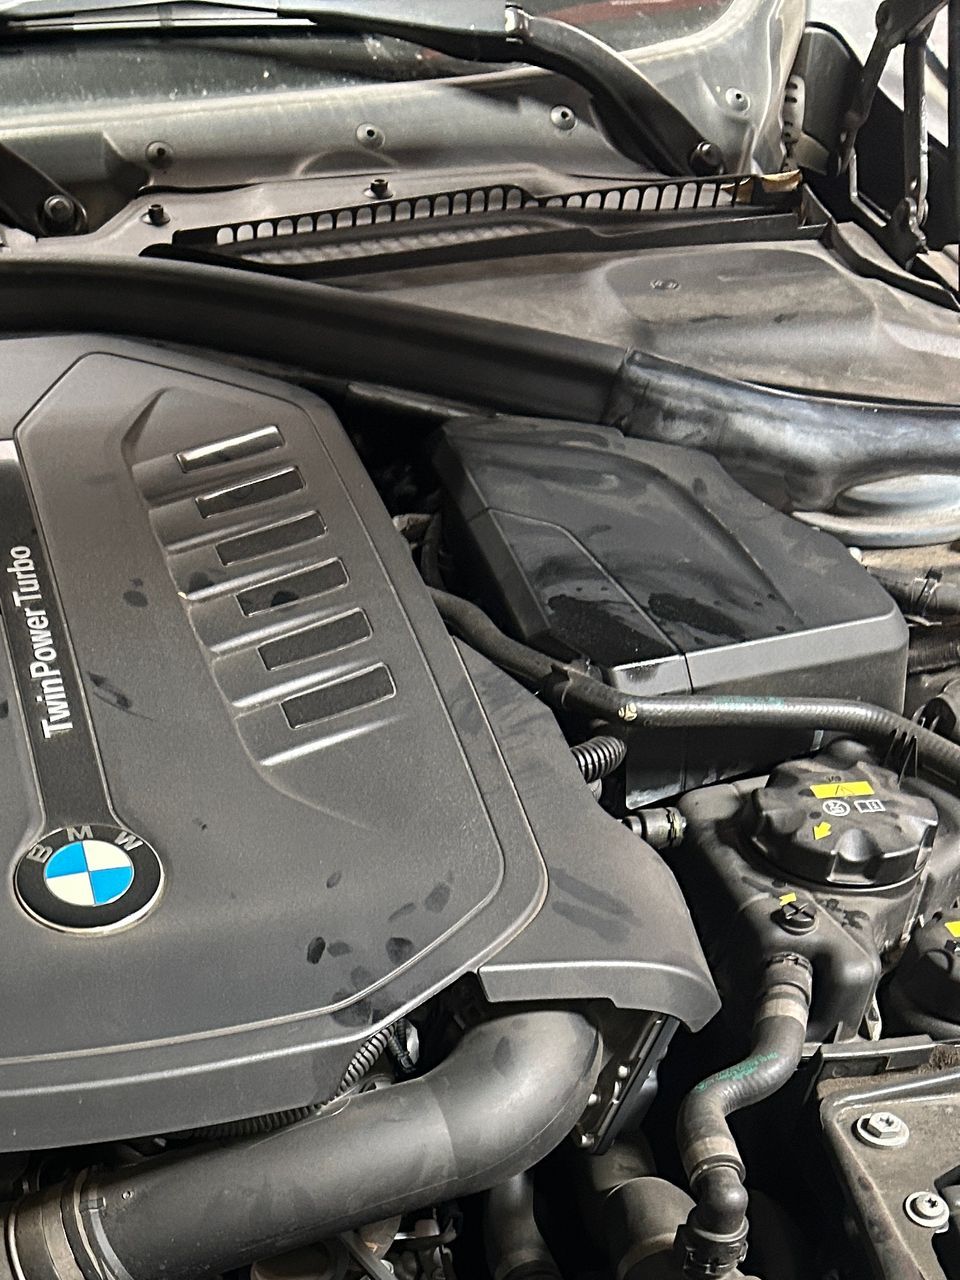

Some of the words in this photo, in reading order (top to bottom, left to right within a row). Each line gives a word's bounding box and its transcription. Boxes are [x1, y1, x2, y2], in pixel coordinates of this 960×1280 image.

[6, 545, 43, 608] Turbo
[24, 607, 74, 739] TwinPower
[25, 825, 144, 864] BMW
